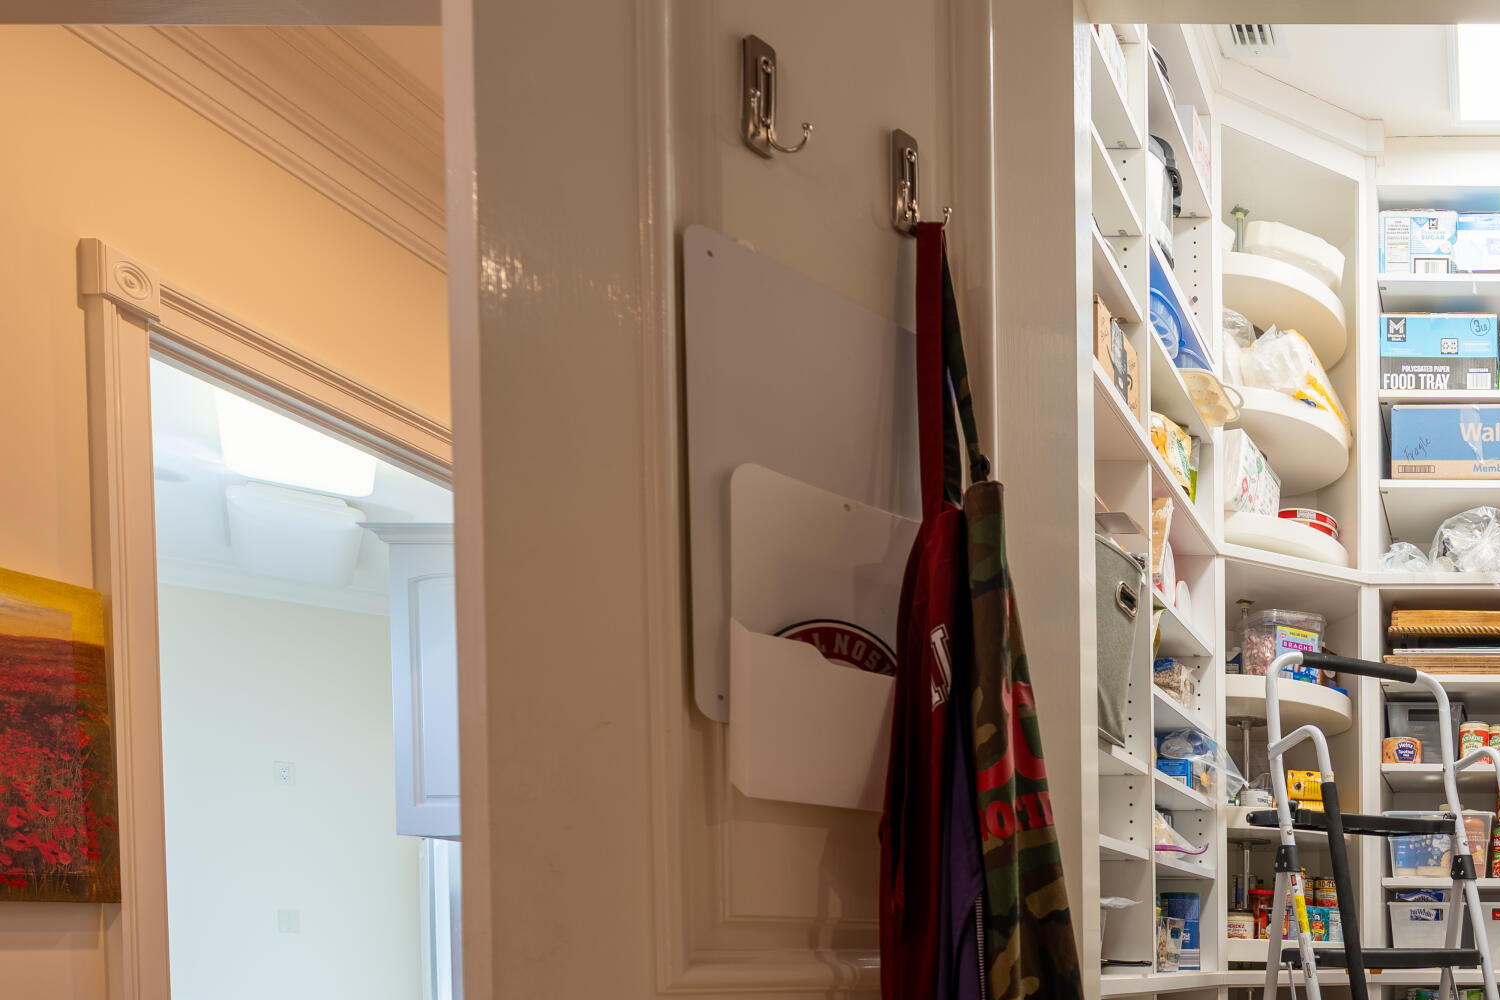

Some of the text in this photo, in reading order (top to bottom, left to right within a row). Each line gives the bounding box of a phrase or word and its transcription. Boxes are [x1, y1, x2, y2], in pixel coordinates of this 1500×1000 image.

[1402, 365, 1450, 373] POLYCOATED PAPER
[1383, 373, 1450, 390] FOOD TRAY
